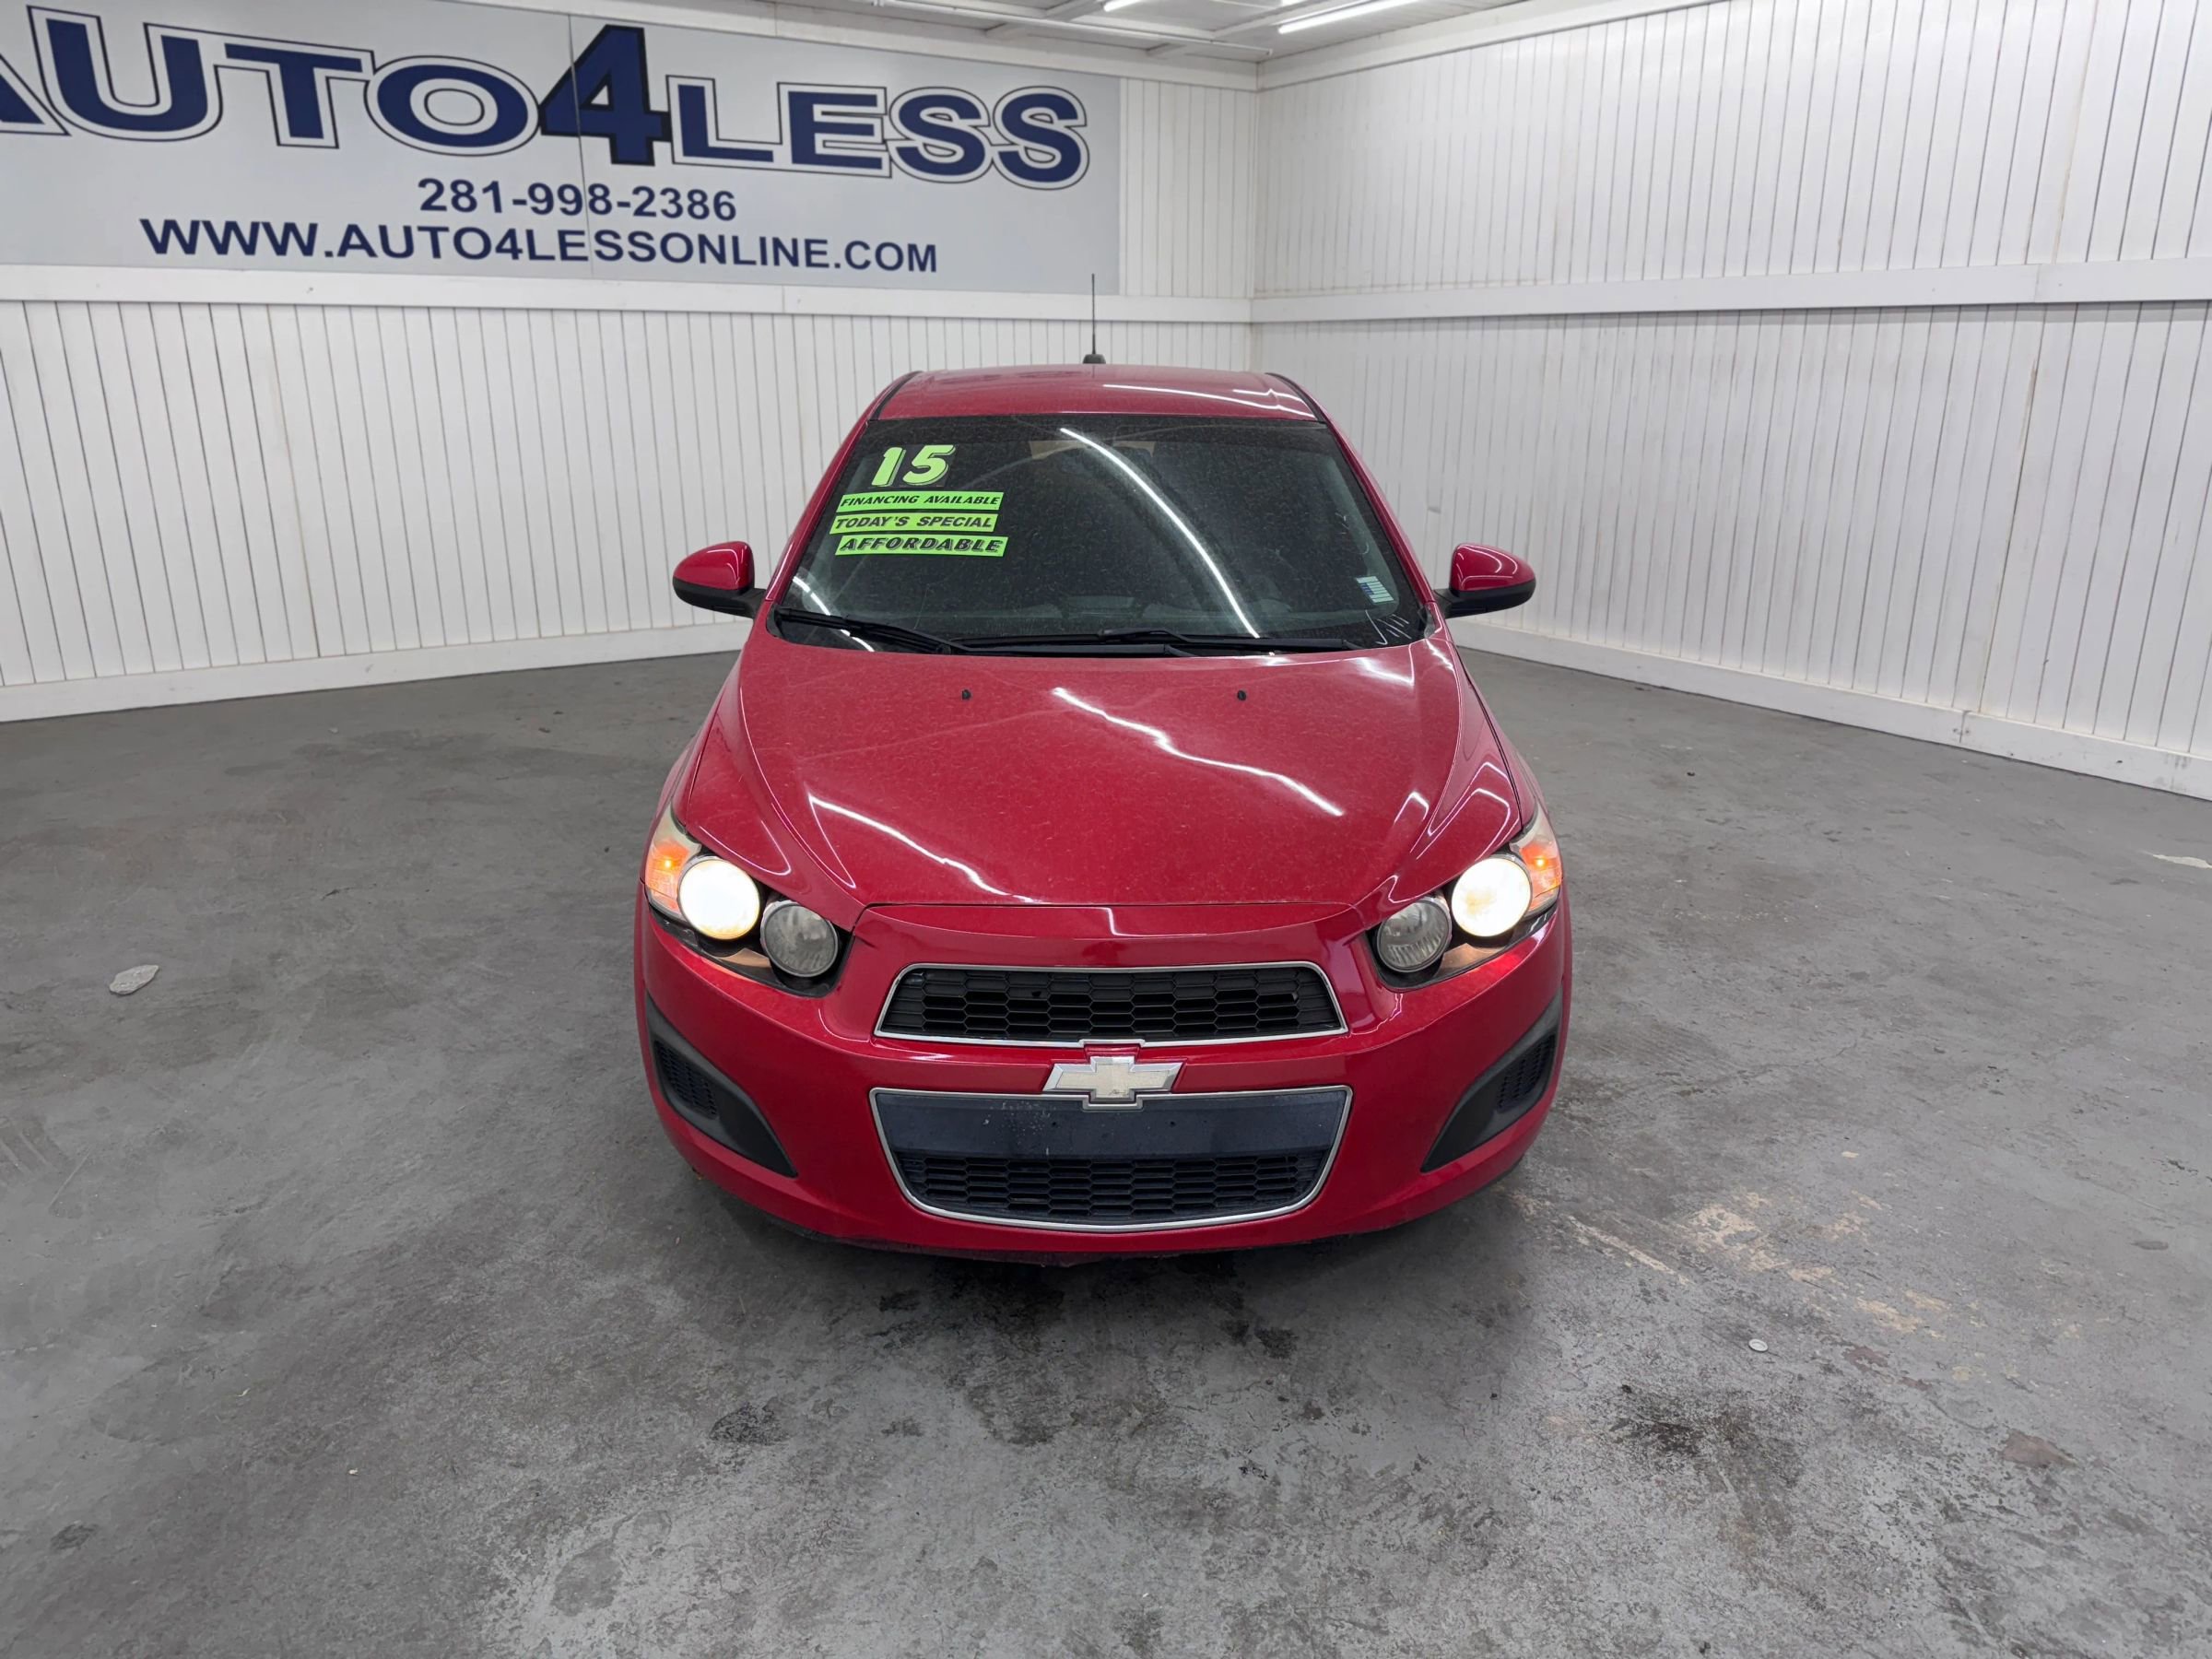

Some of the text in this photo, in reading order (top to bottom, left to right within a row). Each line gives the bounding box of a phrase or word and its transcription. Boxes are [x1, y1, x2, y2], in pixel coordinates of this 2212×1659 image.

[419, 178, 736, 221] 281-998-2386
[140, 218, 936, 273] WWW.AUTO4LESSONLINE.COM
[871, 444, 956, 487] 15
[841, 495, 1000, 507] FINANCING AVAILABLE
[835, 515, 993, 529] TODAY'S SPECIAL
[840, 537, 1004, 552] AFFORDABLE
